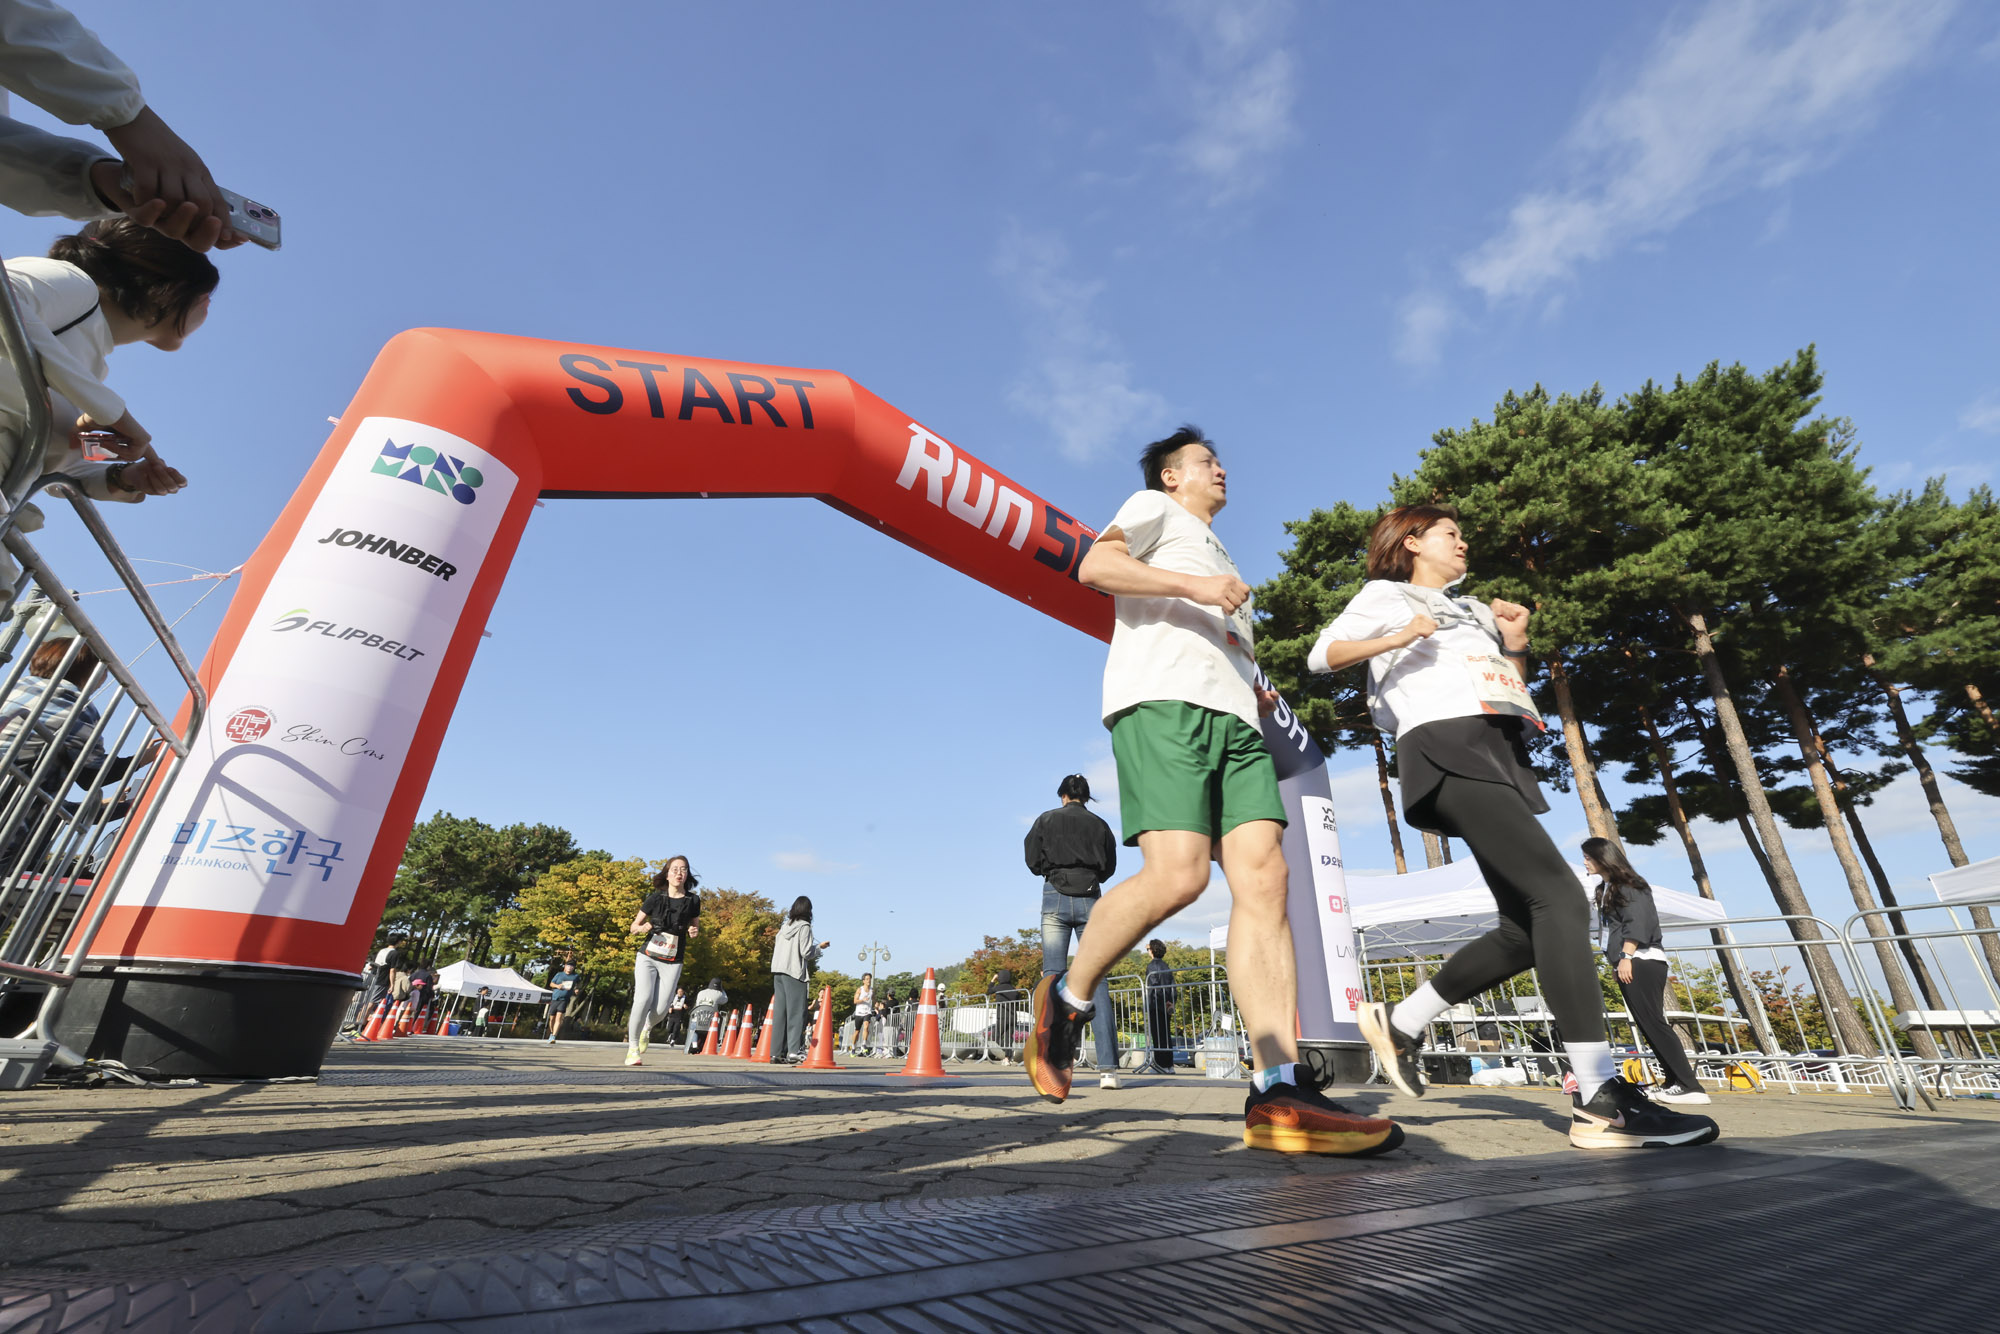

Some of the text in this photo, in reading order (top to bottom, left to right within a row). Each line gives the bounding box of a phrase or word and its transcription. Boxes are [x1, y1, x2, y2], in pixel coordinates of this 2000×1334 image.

[558, 353, 816, 430] START
[317, 528, 457, 581] JOHNBER
[304, 620, 425, 662] FLIPBELT
[280, 724, 337, 746] Skin
[170, 818, 345, 882] 비즈한국
